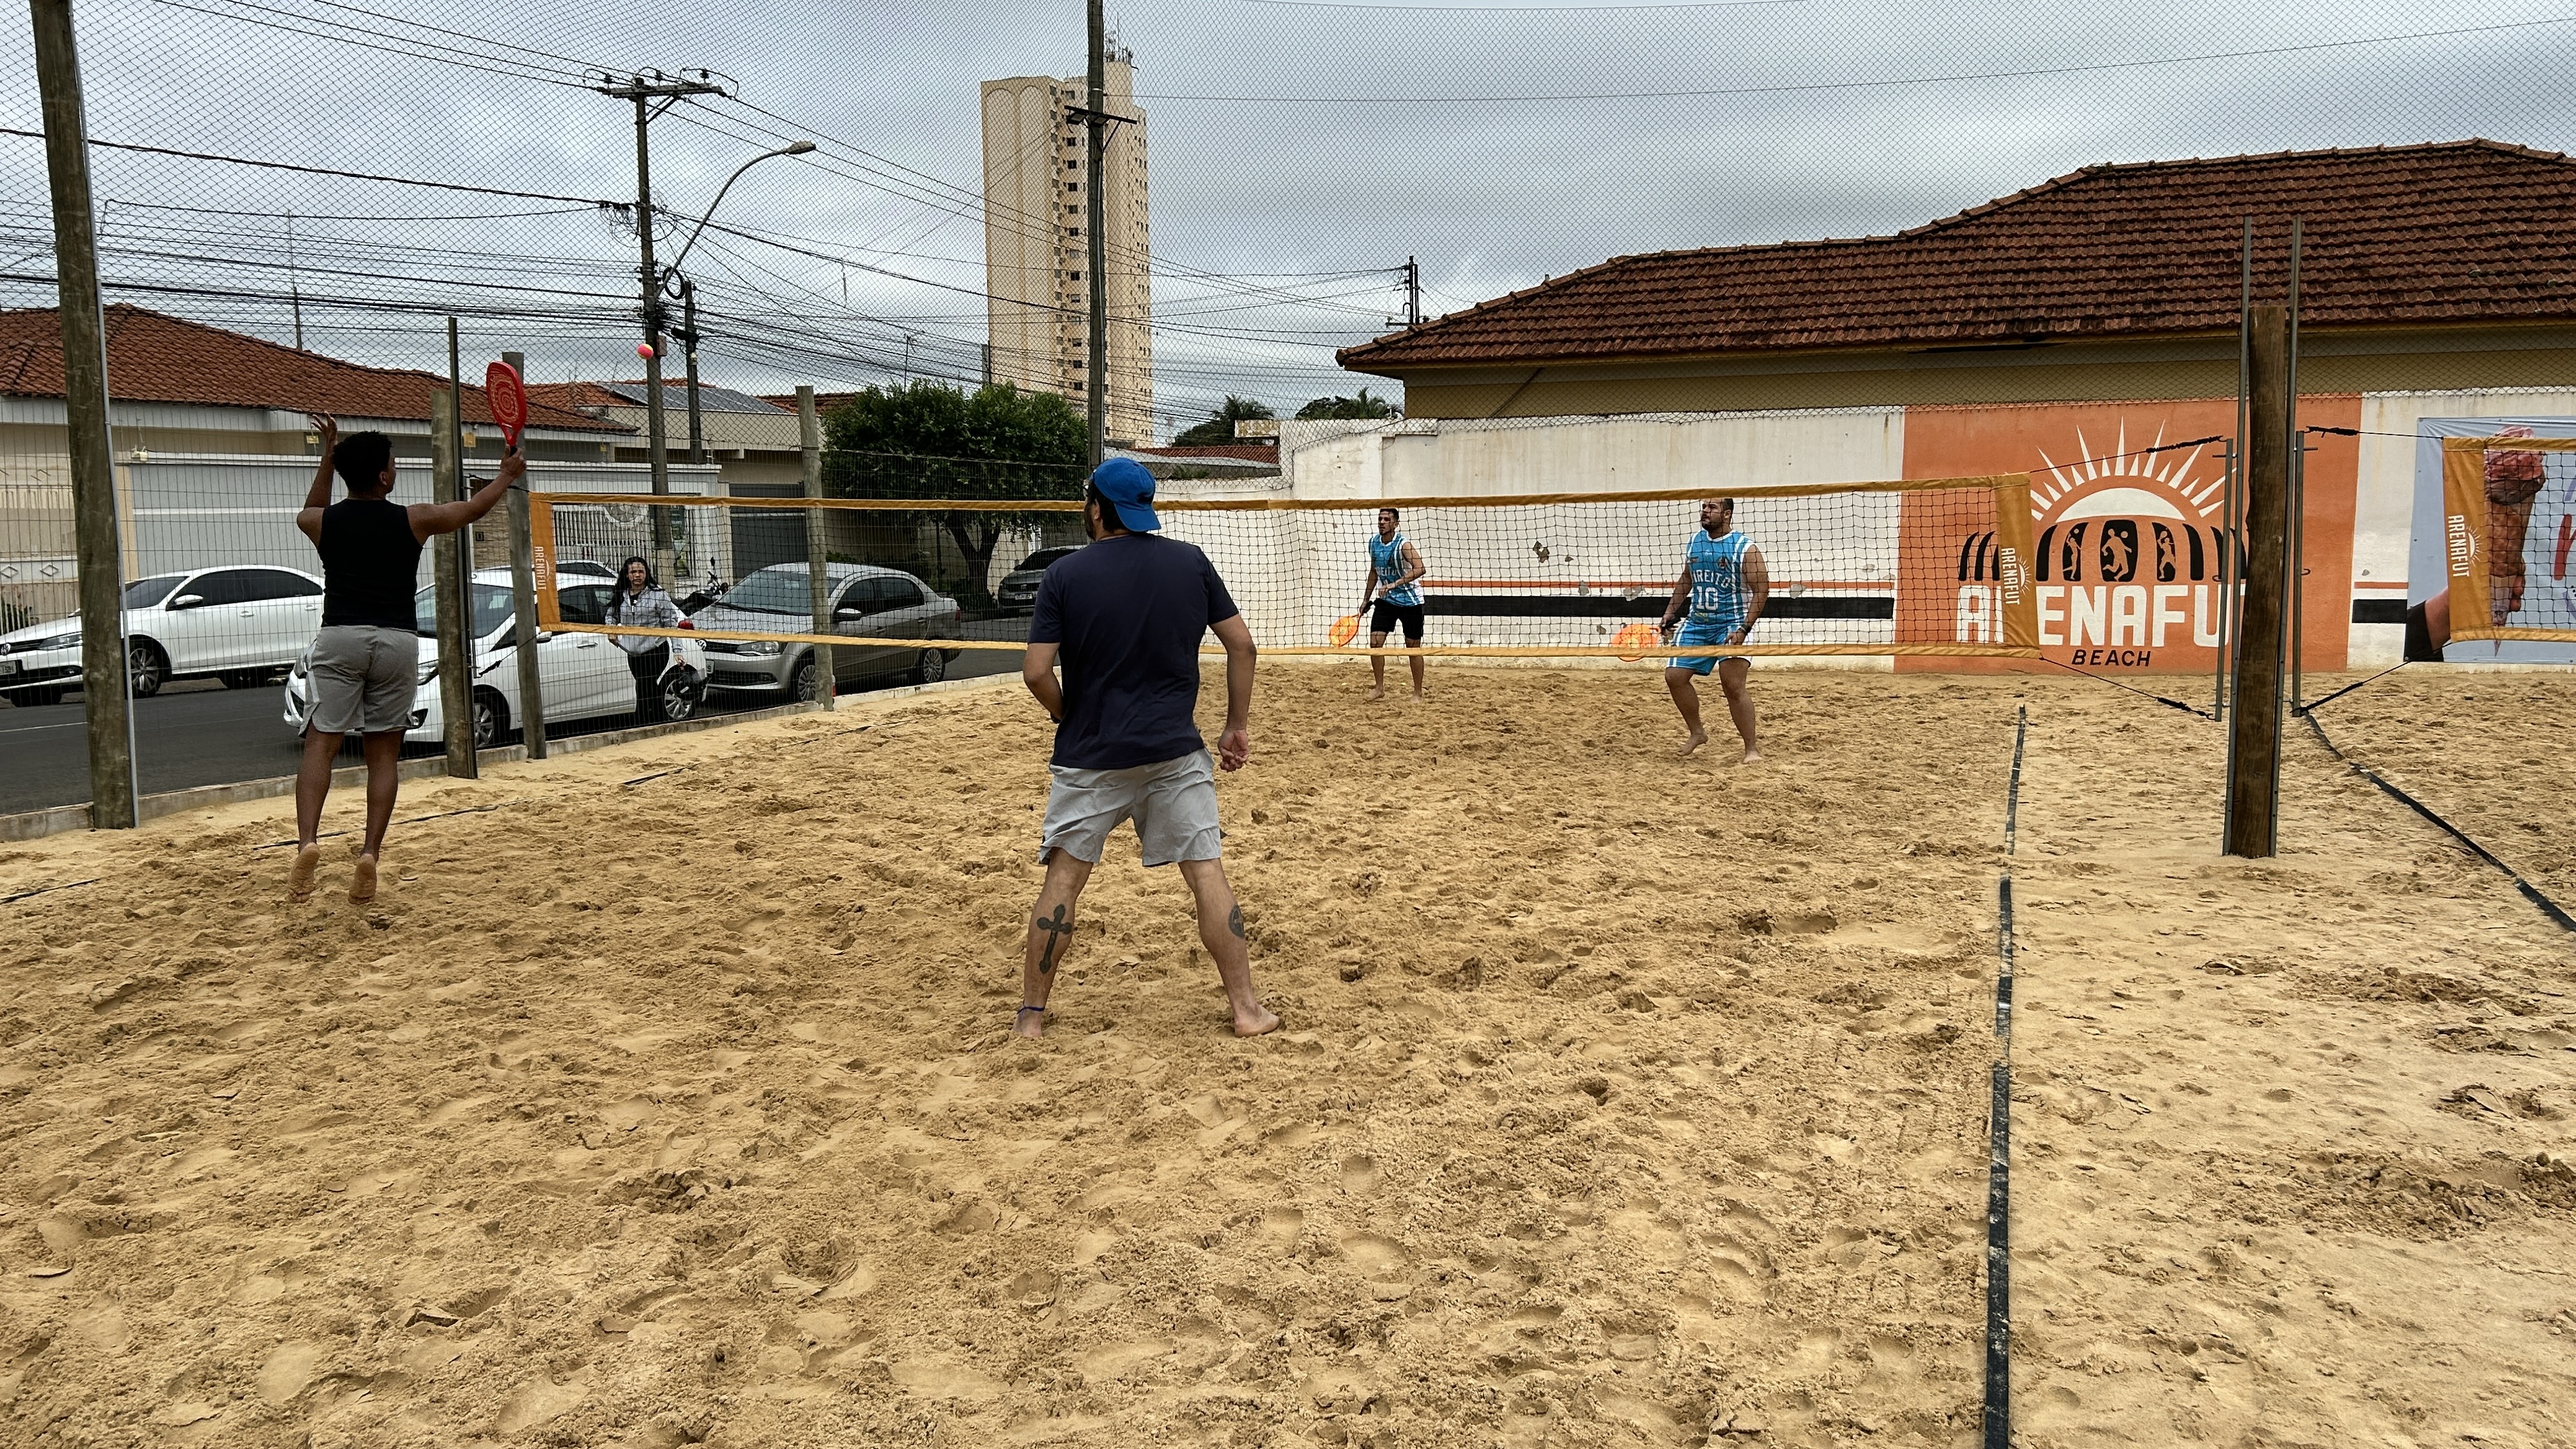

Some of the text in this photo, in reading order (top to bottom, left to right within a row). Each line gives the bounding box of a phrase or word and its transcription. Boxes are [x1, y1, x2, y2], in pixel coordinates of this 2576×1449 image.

[534, 546, 546, 590] ARENAFUT
[2448, 514, 2469, 578] ARENAFUT
[1691, 569, 1731, 588] IREITO
[1696, 585, 1718, 610] 10
[2001, 548, 2020, 605] ARENAFUT
[1956, 584, 2246, 647] AENAFU
[2071, 649, 2151, 667] BEACH
